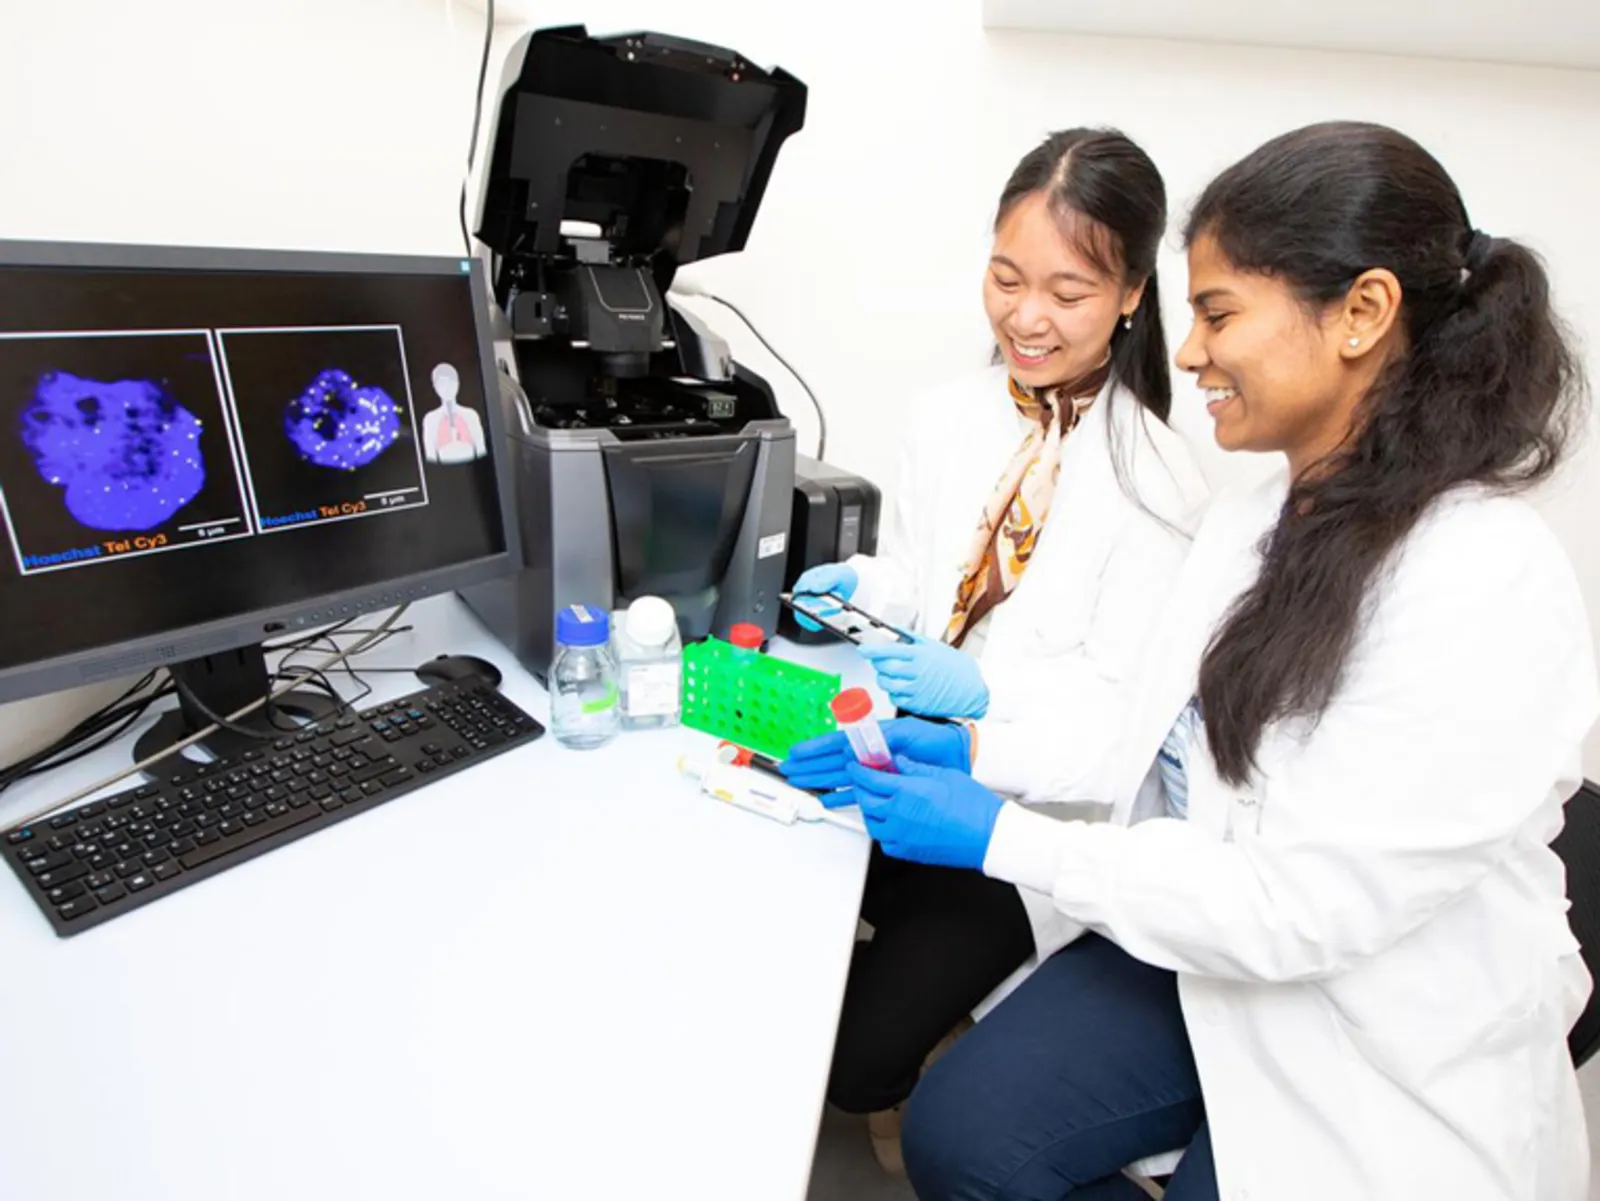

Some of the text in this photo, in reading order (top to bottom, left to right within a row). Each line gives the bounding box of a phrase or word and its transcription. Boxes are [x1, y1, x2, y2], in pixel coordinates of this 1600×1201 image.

[319, 505, 340, 517] Tel
[341, 500, 368, 515] Cy3
[103, 539, 131, 554] Tel
[134, 532, 168, 549] Cy3
